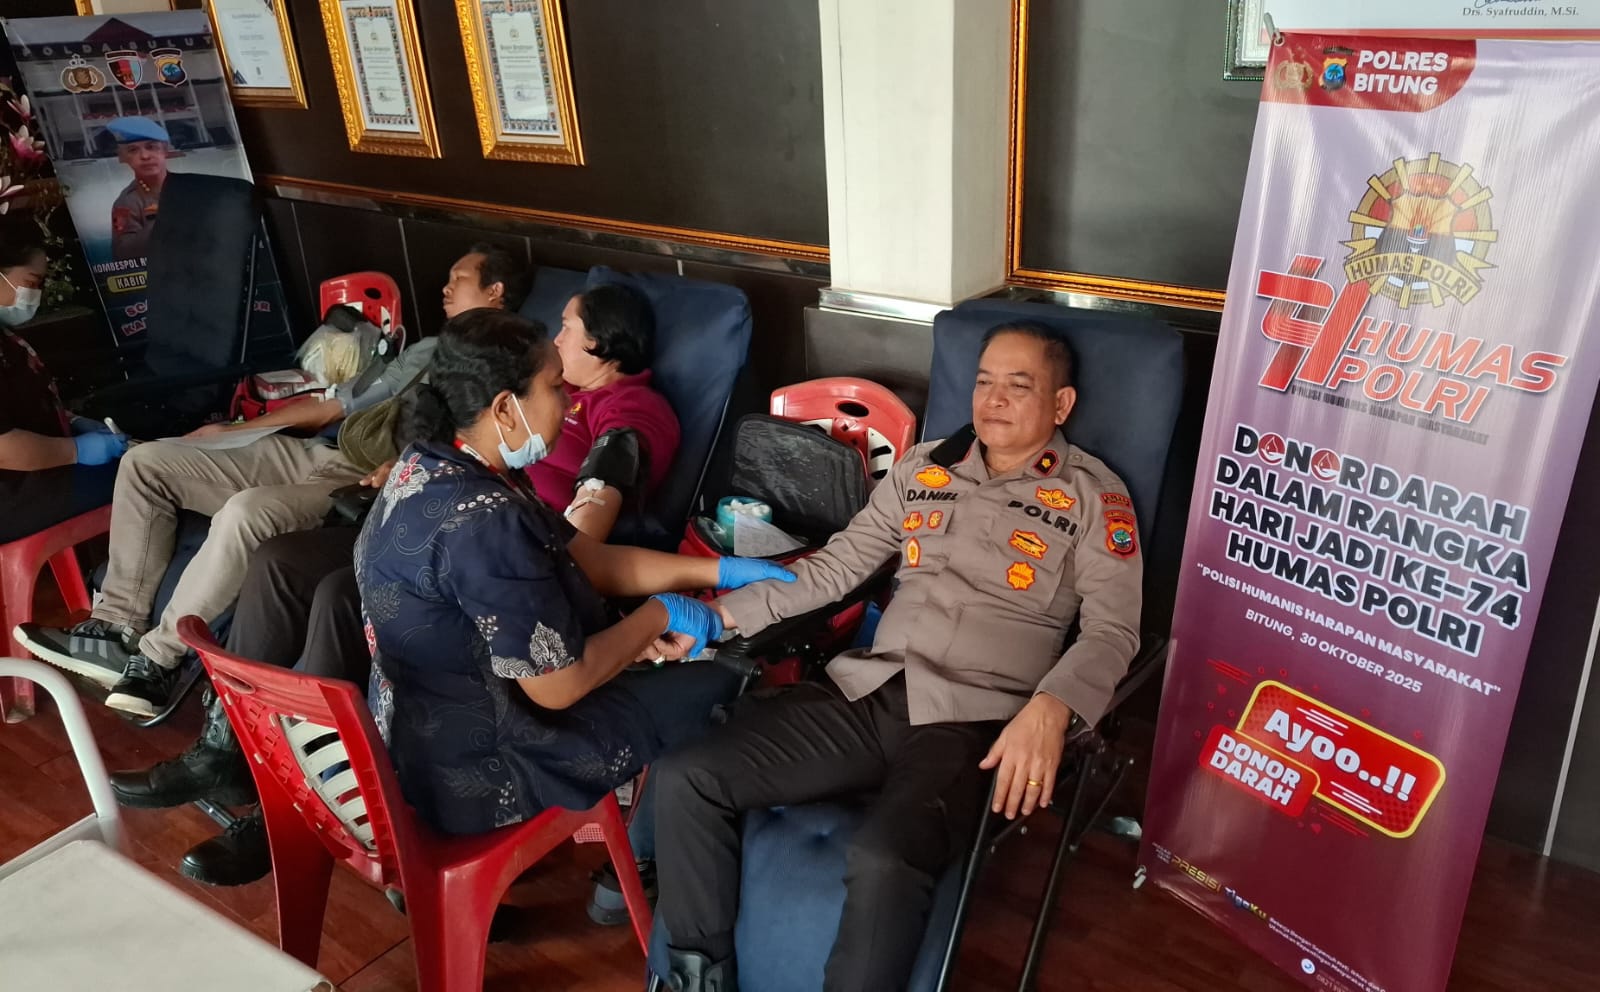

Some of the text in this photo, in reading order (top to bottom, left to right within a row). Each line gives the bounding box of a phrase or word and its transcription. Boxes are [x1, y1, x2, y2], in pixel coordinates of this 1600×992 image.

[1353, 73, 1439, 95] BITUNG
[1357, 50, 1449, 72] POLRES
[1350, 255, 1474, 300] HUMAS POLRI
[1328, 356, 1489, 423] POLRI
[1348, 315, 1568, 394] HUMAS
[1007, 500, 1078, 537] POLRI
[1216, 455, 1530, 590] DALAM RANGKA
[1369, 464, 1530, 542] DARAH
[1210, 491, 1522, 629] HARI JADI KE-74
[1226, 532, 1484, 657] HUMAS POLRI
[1197, 563, 1501, 696] "POLISI HUMANIS HARAPAN MASYARAKAT"
[1245, 608, 1423, 693] BITUNG, 30 OKTOBER 2025
[1210, 750, 1293, 806] DARAH
[1218, 733, 1301, 789] DONOR
[1264, 708, 1416, 802] Ayoo..!!
